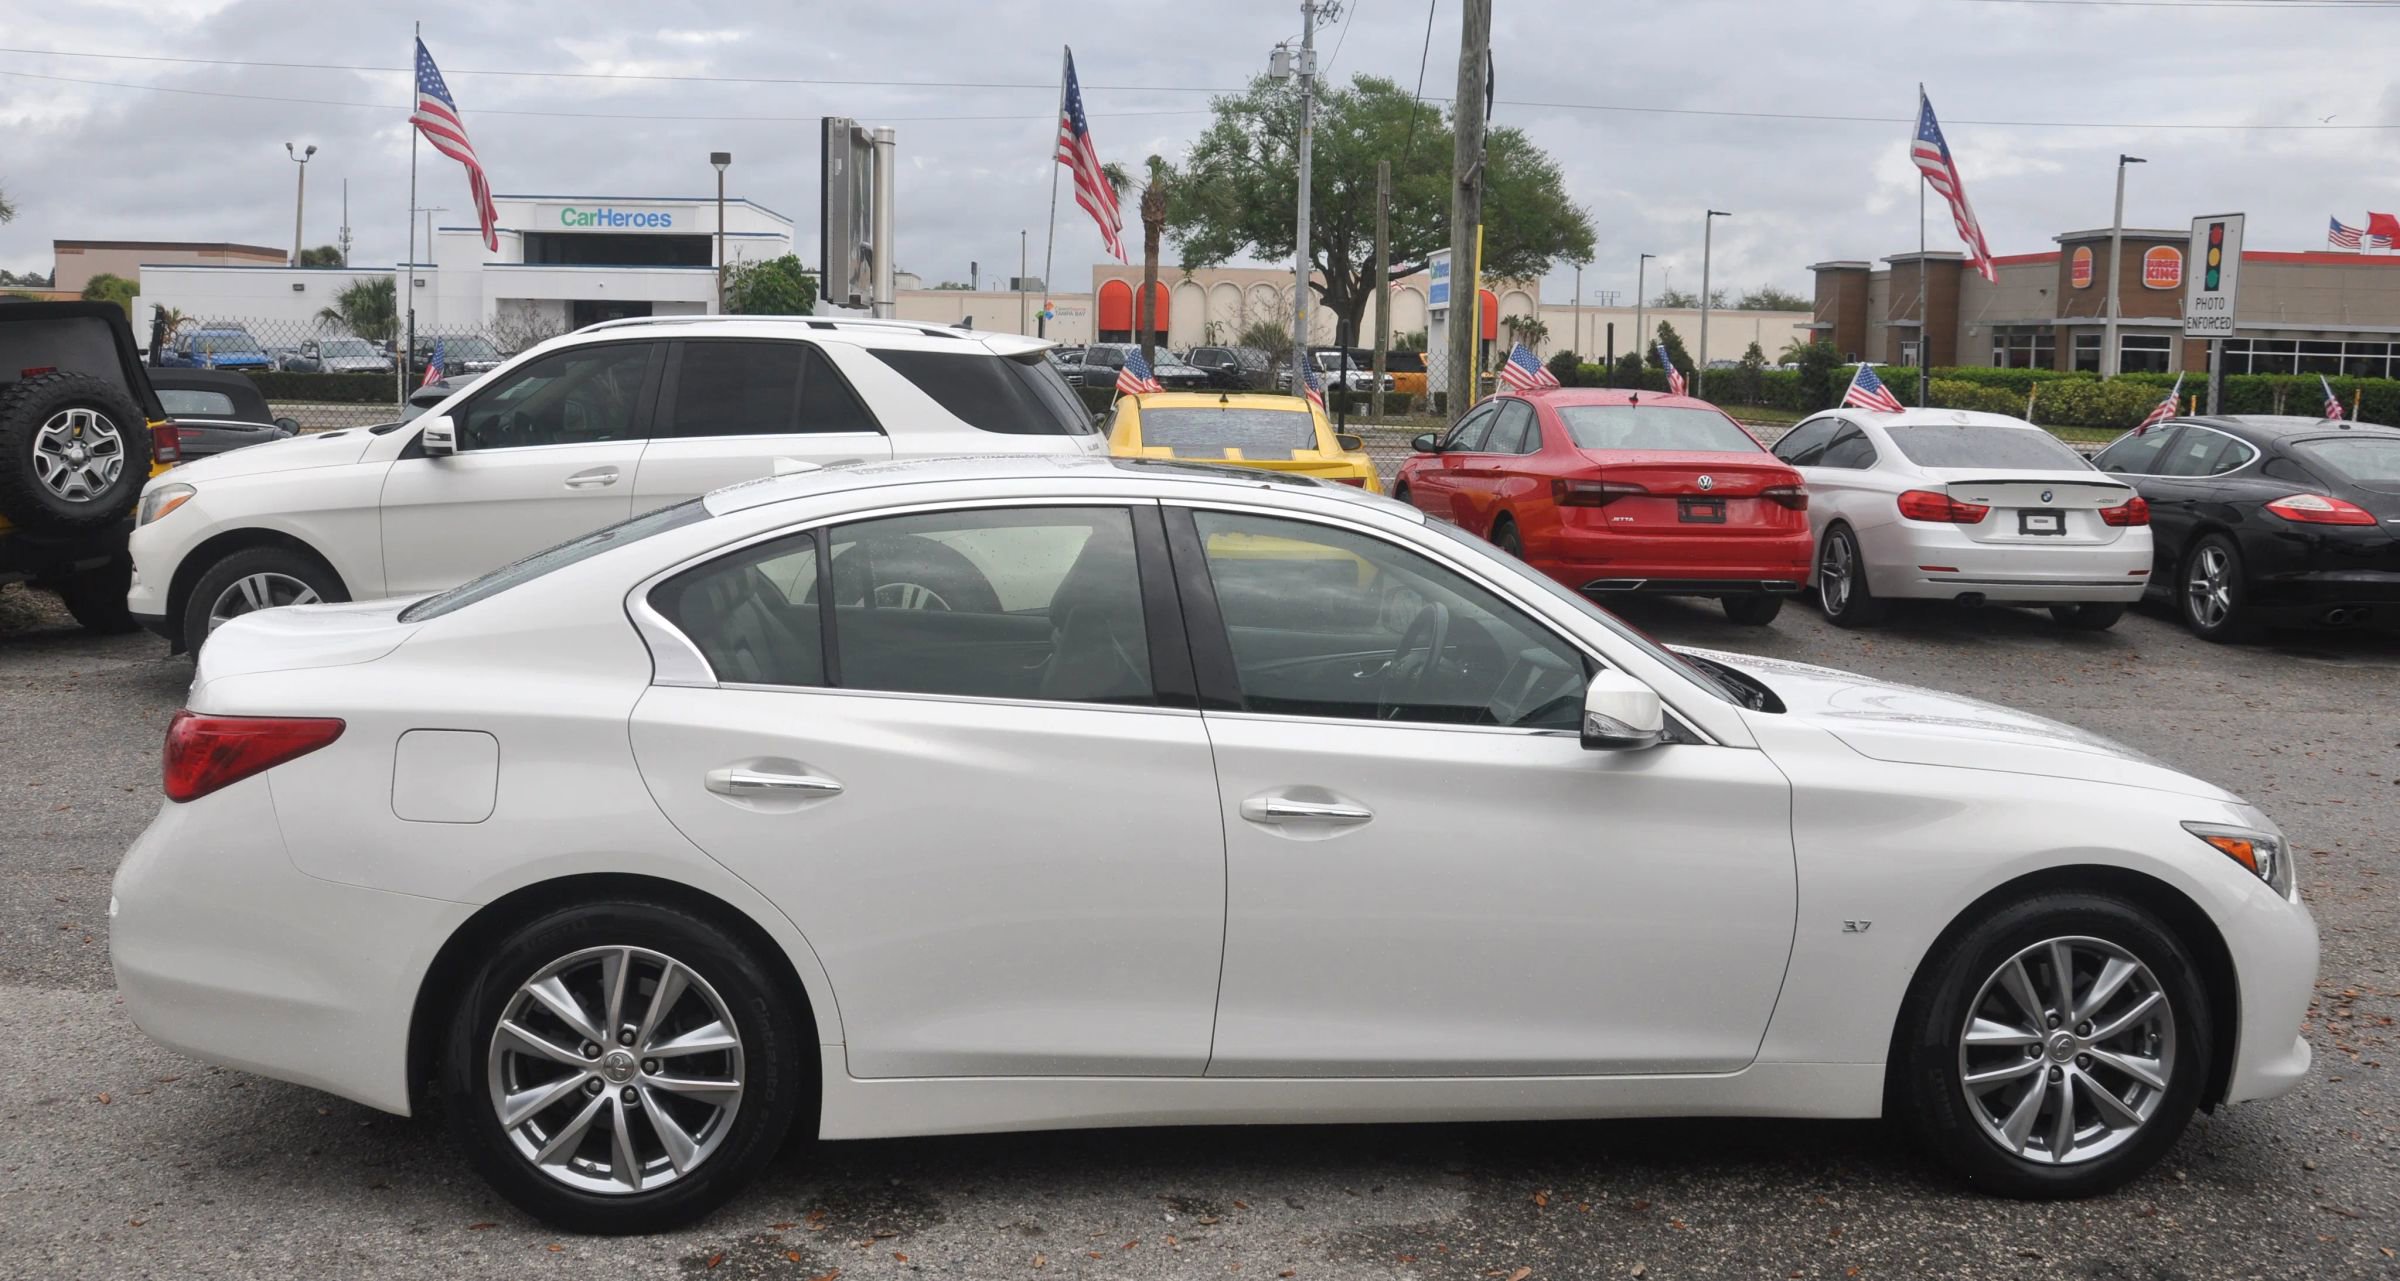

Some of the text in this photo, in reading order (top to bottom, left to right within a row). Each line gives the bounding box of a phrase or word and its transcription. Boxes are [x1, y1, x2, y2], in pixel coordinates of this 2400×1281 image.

[561, 207, 672, 227] CarHeroes
[2146, 259, 2180, 268] BURGER
[2146, 268, 2179, 280] KING
[2195, 297, 2225, 310] PHOTO
[2187, 316, 2232, 329] ENFORCED
